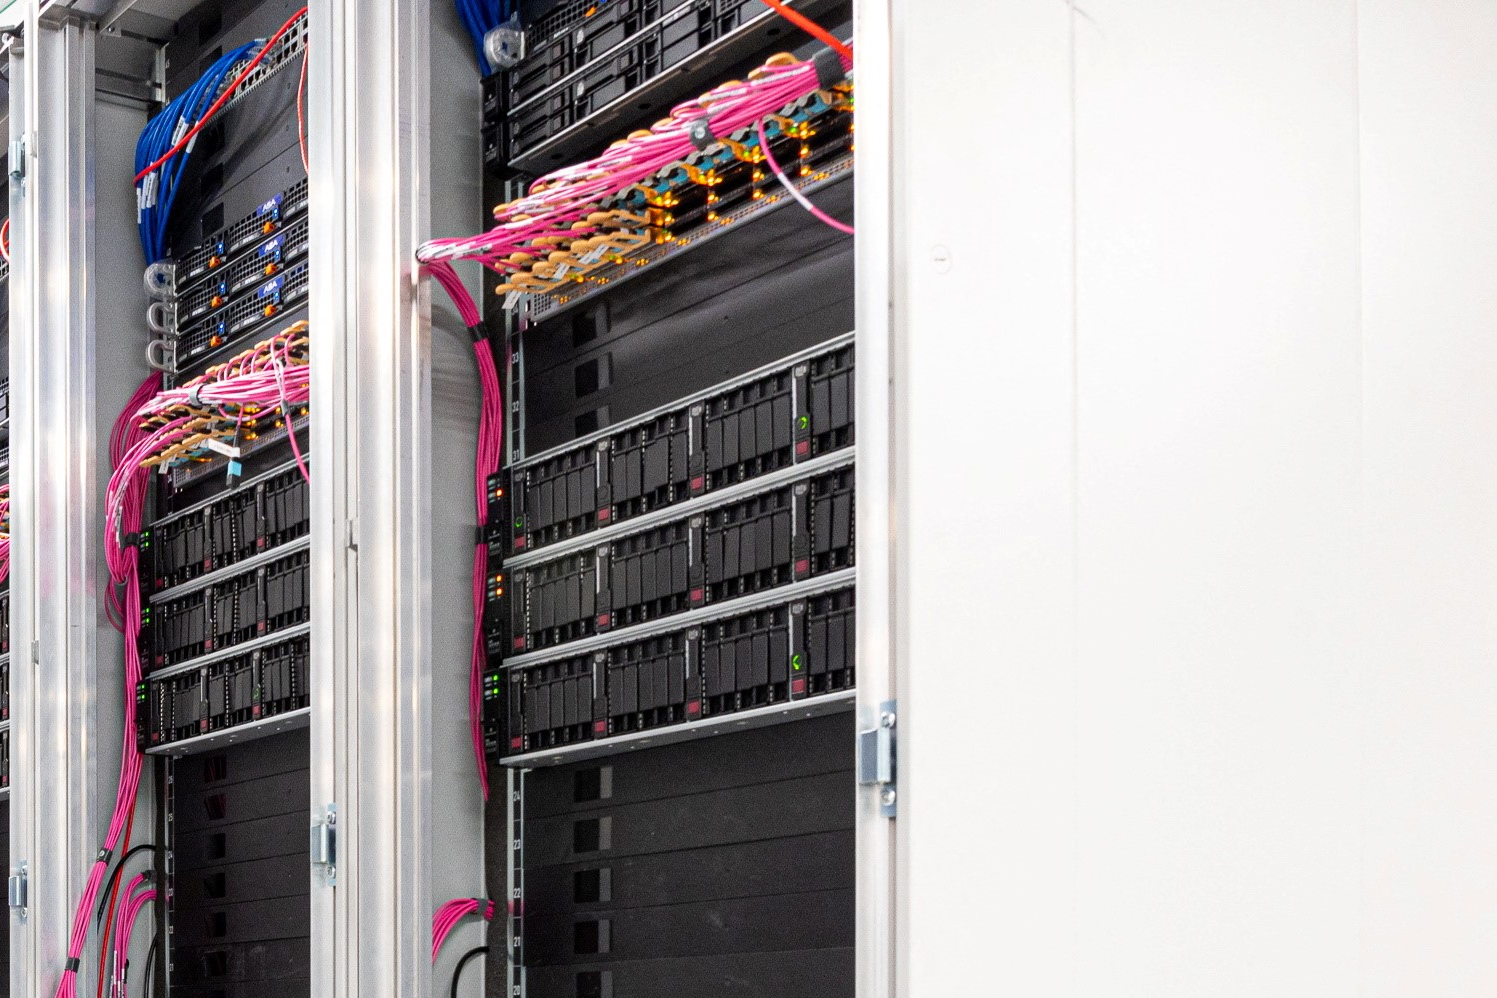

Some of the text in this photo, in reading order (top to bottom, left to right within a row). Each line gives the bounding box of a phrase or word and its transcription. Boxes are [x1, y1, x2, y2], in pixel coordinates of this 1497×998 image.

[512, 400, 520, 413] 32
[512, 449, 520, 461] 31
[513, 838, 521, 850] 23
[513, 887, 521, 899] 22
[513, 936, 521, 947] 21
[513, 985, 521, 996] 20
